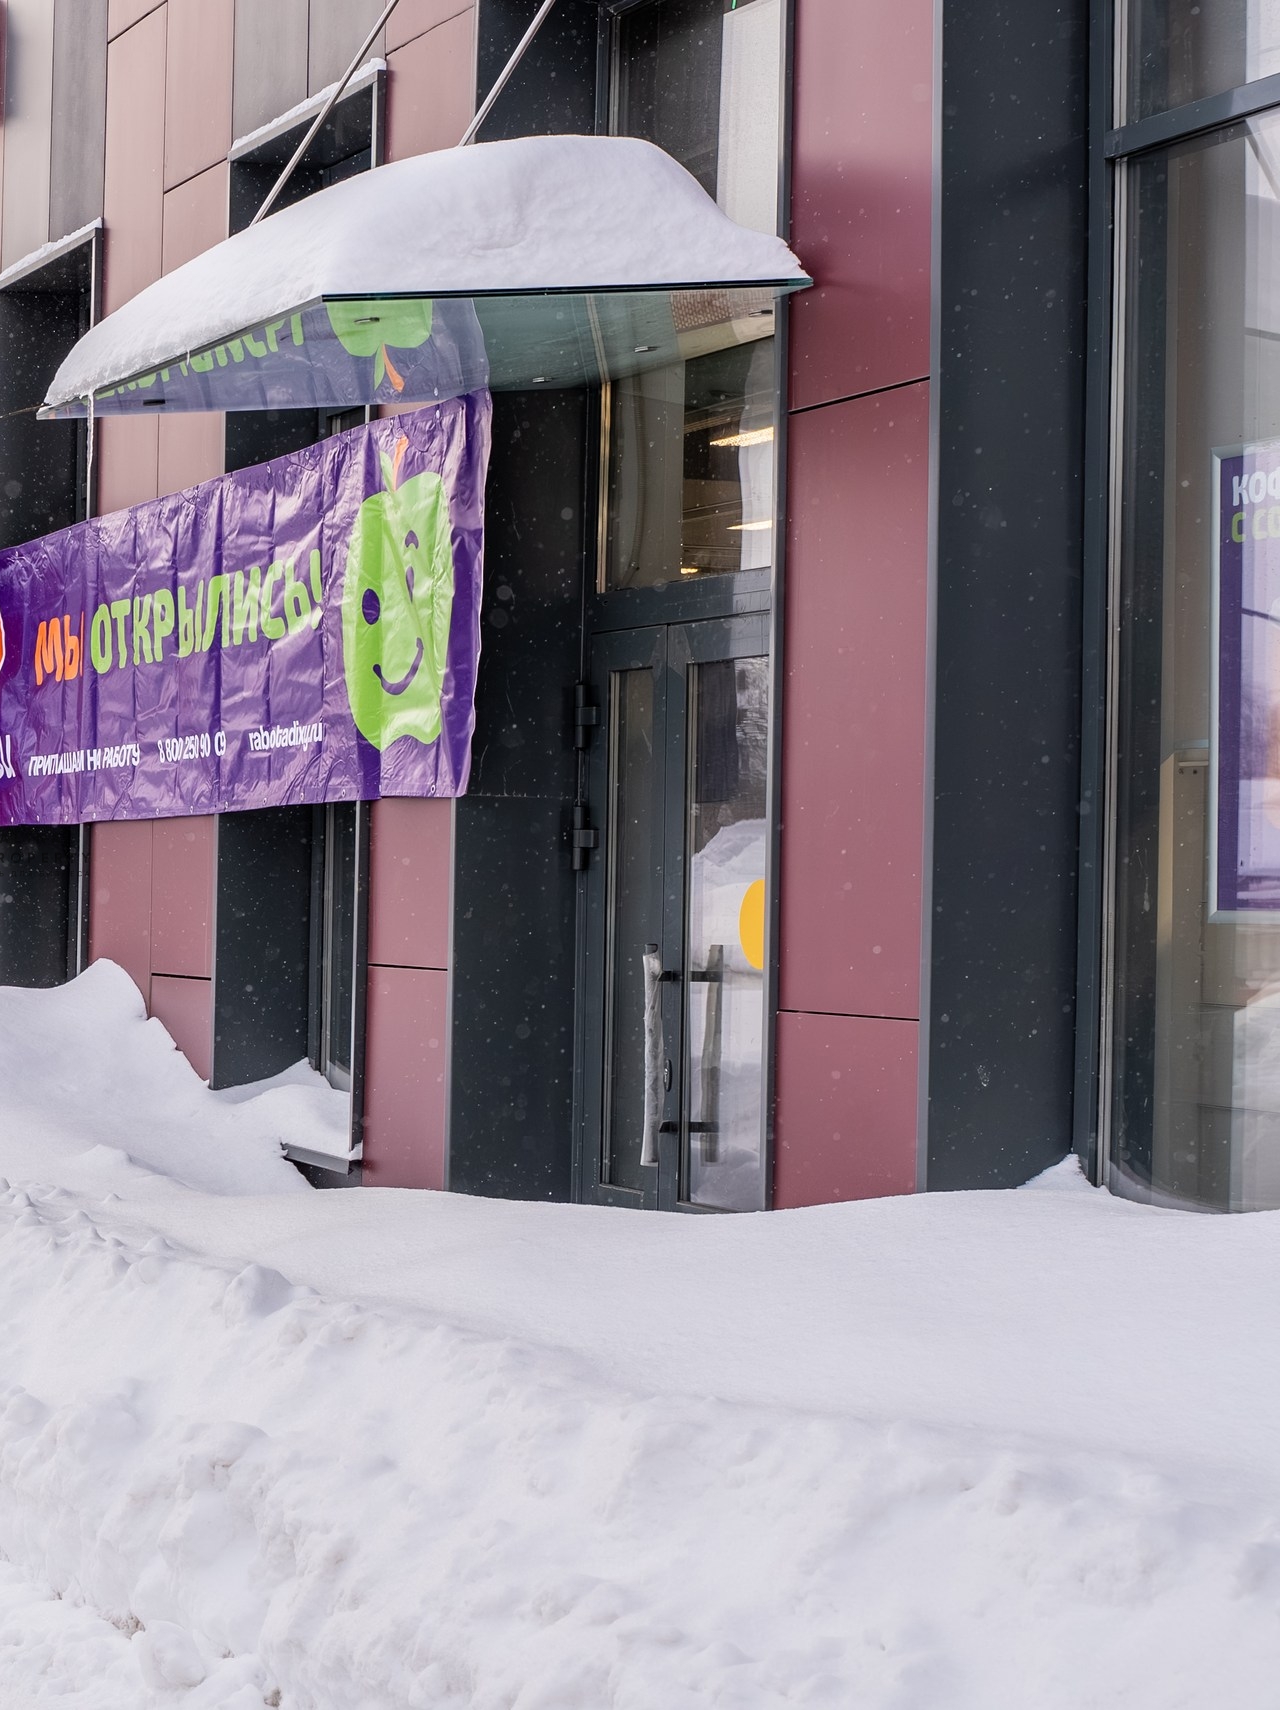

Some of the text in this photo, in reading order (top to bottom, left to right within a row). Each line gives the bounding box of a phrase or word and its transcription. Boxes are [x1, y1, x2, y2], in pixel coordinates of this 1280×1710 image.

[90, 549, 323, 674] ОТКРЫЛИСЬ!
[87, 748, 101, 771] НА
[102, 743, 140, 768] РАБОТУ
[157, 740, 165, 763] 8
[200, 732, 211, 758] 90
